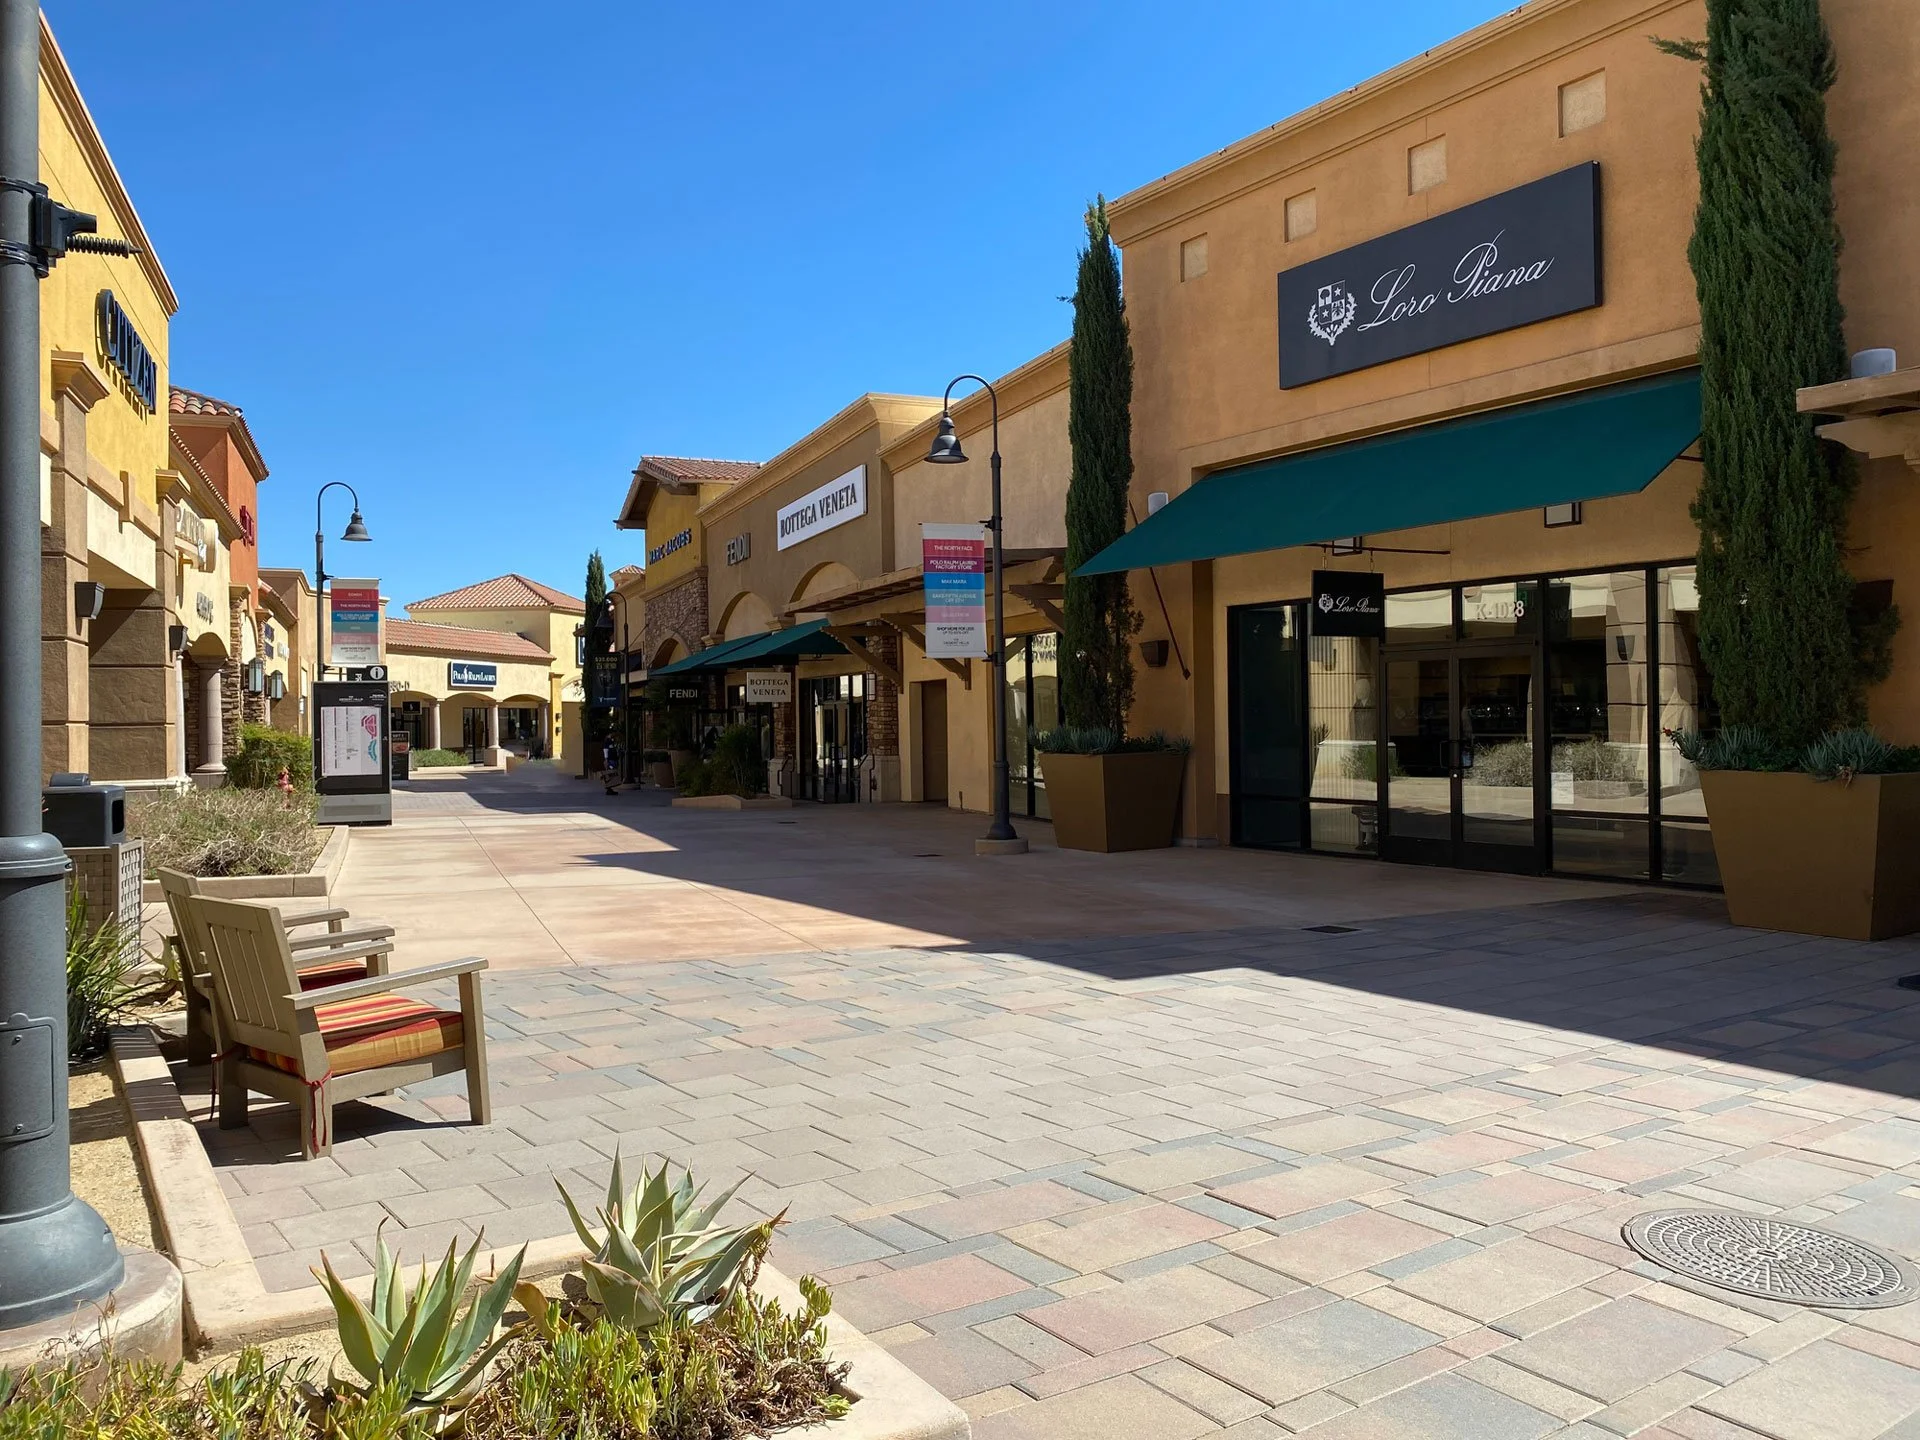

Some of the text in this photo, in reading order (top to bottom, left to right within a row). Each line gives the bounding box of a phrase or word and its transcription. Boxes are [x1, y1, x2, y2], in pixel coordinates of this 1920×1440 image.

[1357, 229, 1554, 331] Loro Piana
[99, 289, 157, 415] CITIZEN
[780, 483, 857, 538] BOTTEGA VENETA
[727, 532, 751, 566] FENDI
[1332, 596, 1380, 613] Loro Piana
[669, 689, 698, 699] FENDI
[752, 688, 786, 696] VENETA
